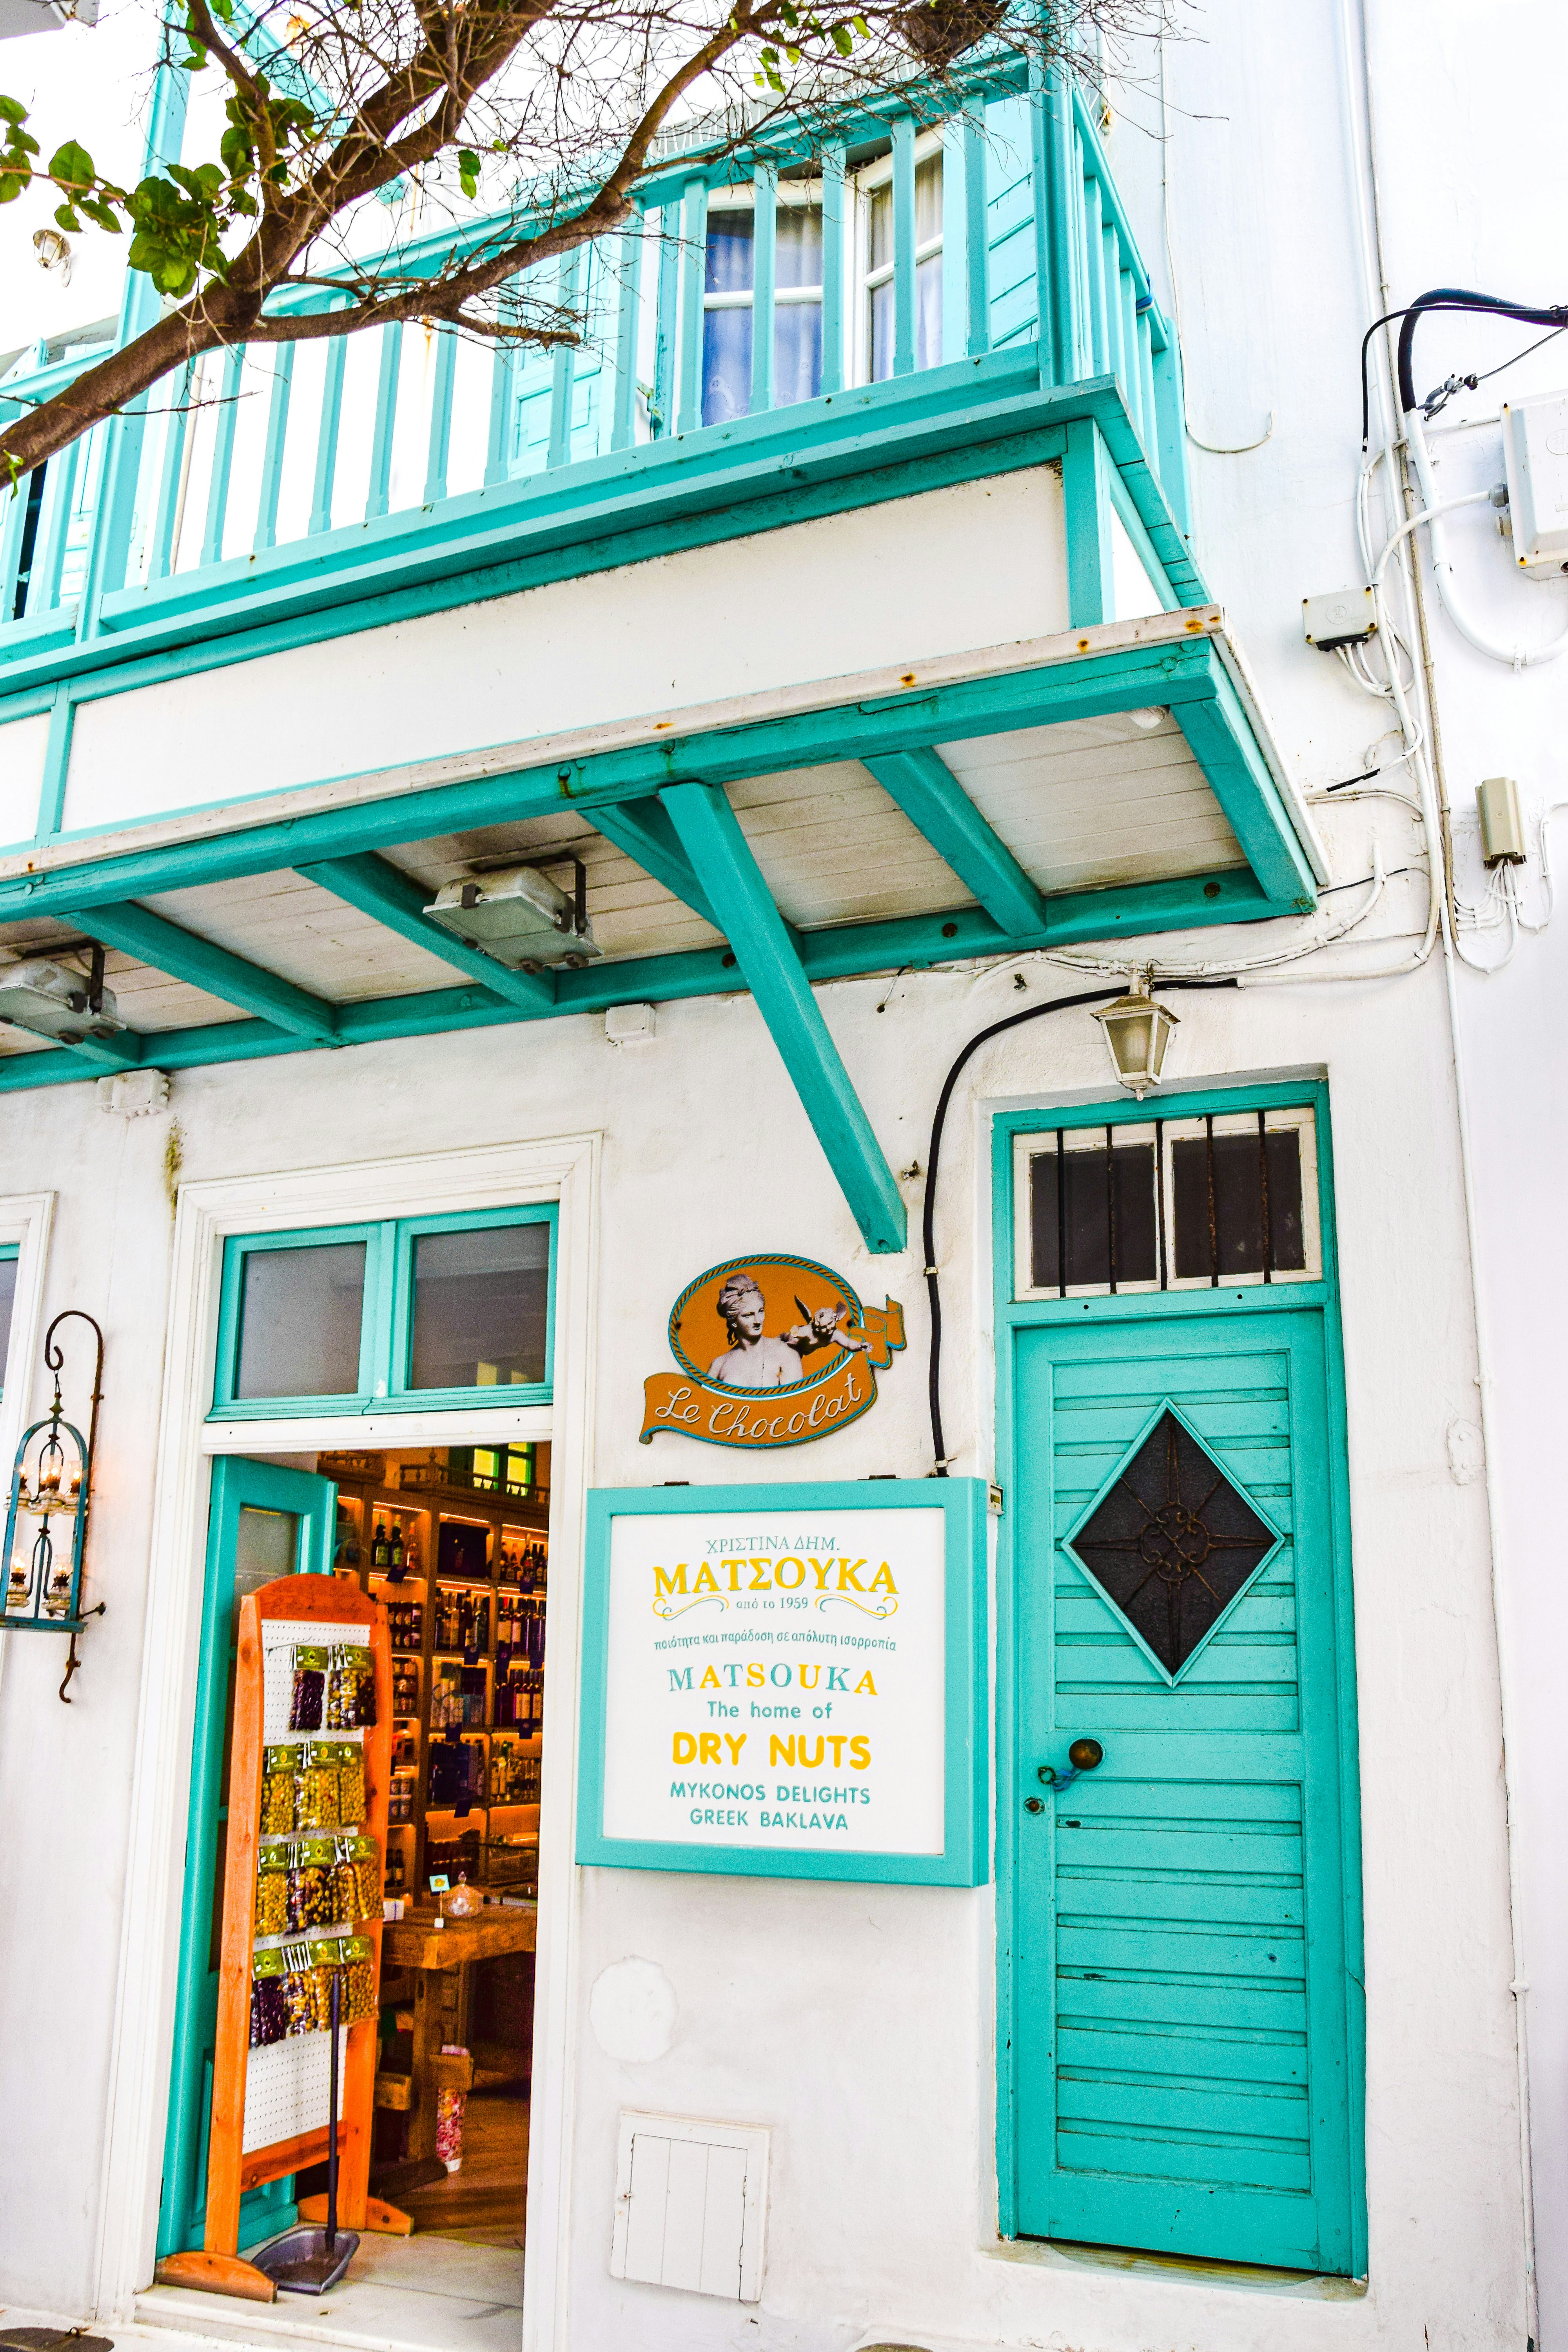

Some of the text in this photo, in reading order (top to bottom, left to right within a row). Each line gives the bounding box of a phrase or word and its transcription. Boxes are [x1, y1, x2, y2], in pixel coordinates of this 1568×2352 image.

[655, 1372, 862, 1438] Le Chocolat
[705, 1535, 840, 1554] ΧΡΙΣΤΙΝΑ ΔΗΜ.
[653, 1556, 899, 1597] ΜΑΤΣΟΥΚΑ
[736, 1597, 808, 1610] από το 1959
[654, 1629, 897, 1651] ποιότητα και παράδοση σε απόλυτη ισορροπία
[668, 1662, 878, 1696] MATSOUKA
[707, 1700, 833, 1719] The home of
[672, 1731, 872, 1771] DRY NUTS
[670, 1782, 871, 1805] MYKONOS DELIGHTS
[690, 1808, 848, 1830] GREEK BAKLAVA
